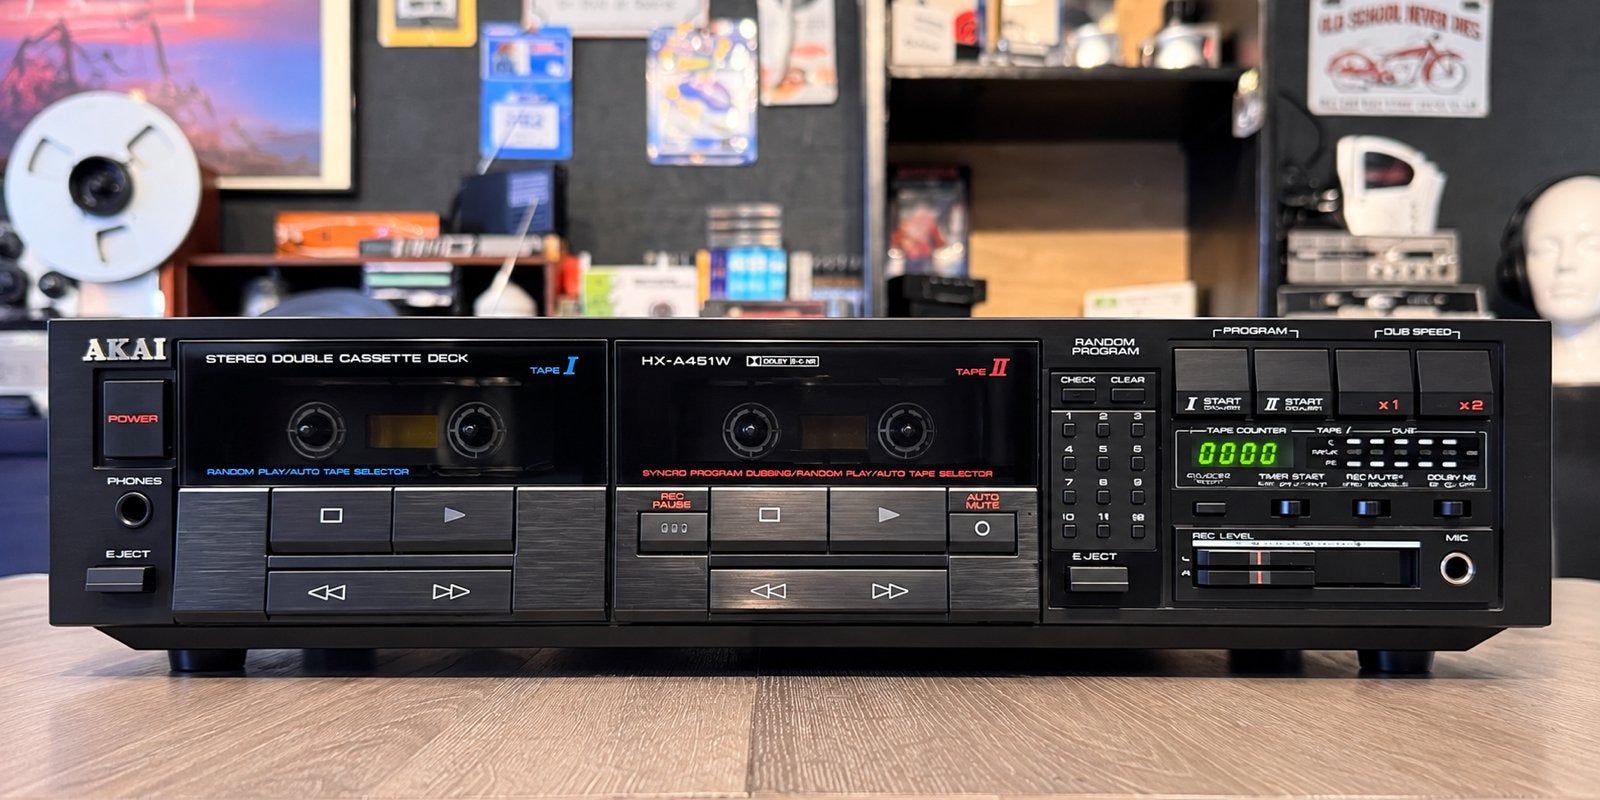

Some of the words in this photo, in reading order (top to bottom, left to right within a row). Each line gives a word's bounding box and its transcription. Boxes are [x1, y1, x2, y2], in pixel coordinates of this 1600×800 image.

[1406, 4, 1447, 30] NEVER
[1222, 326, 1288, 336] PROGRAM
[1383, 326, 1409, 337] DUB
[1412, 327, 1452, 337] SPEED
[1075, 338, 1135, 346] RANDOM
[82, 337, 167, 362] AKAI
[1072, 347, 1140, 355] PROGRAM
[205, 353, 267, 364] STEREO
[271, 353, 334, 364] DOUBLE
[339, 353, 422, 364] CASSETTE
[427, 353, 469, 364] DECK
[641, 356, 731, 366] HX-A451W
[529, 366, 560, 375] TAPE
[955, 368, 987, 376] TAPE
[1060, 376, 1096, 384] CHECK
[1110, 376, 1146, 384] CLEAR
[1203, 397, 1242, 405] START
[1284, 397, 1324, 406] START
[107, 414, 159, 423] POWER
[1065, 412, 1072, 420] 1
[1098, 412, 1109, 420] 2
[1133, 412, 1142, 420] 3
[1064, 445, 1074, 453] 4
[1098, 445, 1108, 453] 5
[1198, 442, 1278, 465] 0000
[107, 477, 162, 485] PHONES
[1064, 478, 1074, 486] 7
[661, 492, 685, 501] REC
[966, 493, 1000, 501] AUTO
[652, 501, 691, 509] PAUSE
[965, 501, 1000, 509] MUTE
[1192, 532, 1216, 540] REC
[1219, 532, 1254, 540] LEVEL
[1445, 534, 1469, 542] MIC
[106, 550, 151, 558] EJECT
[1072, 552, 1118, 560] EJECT
